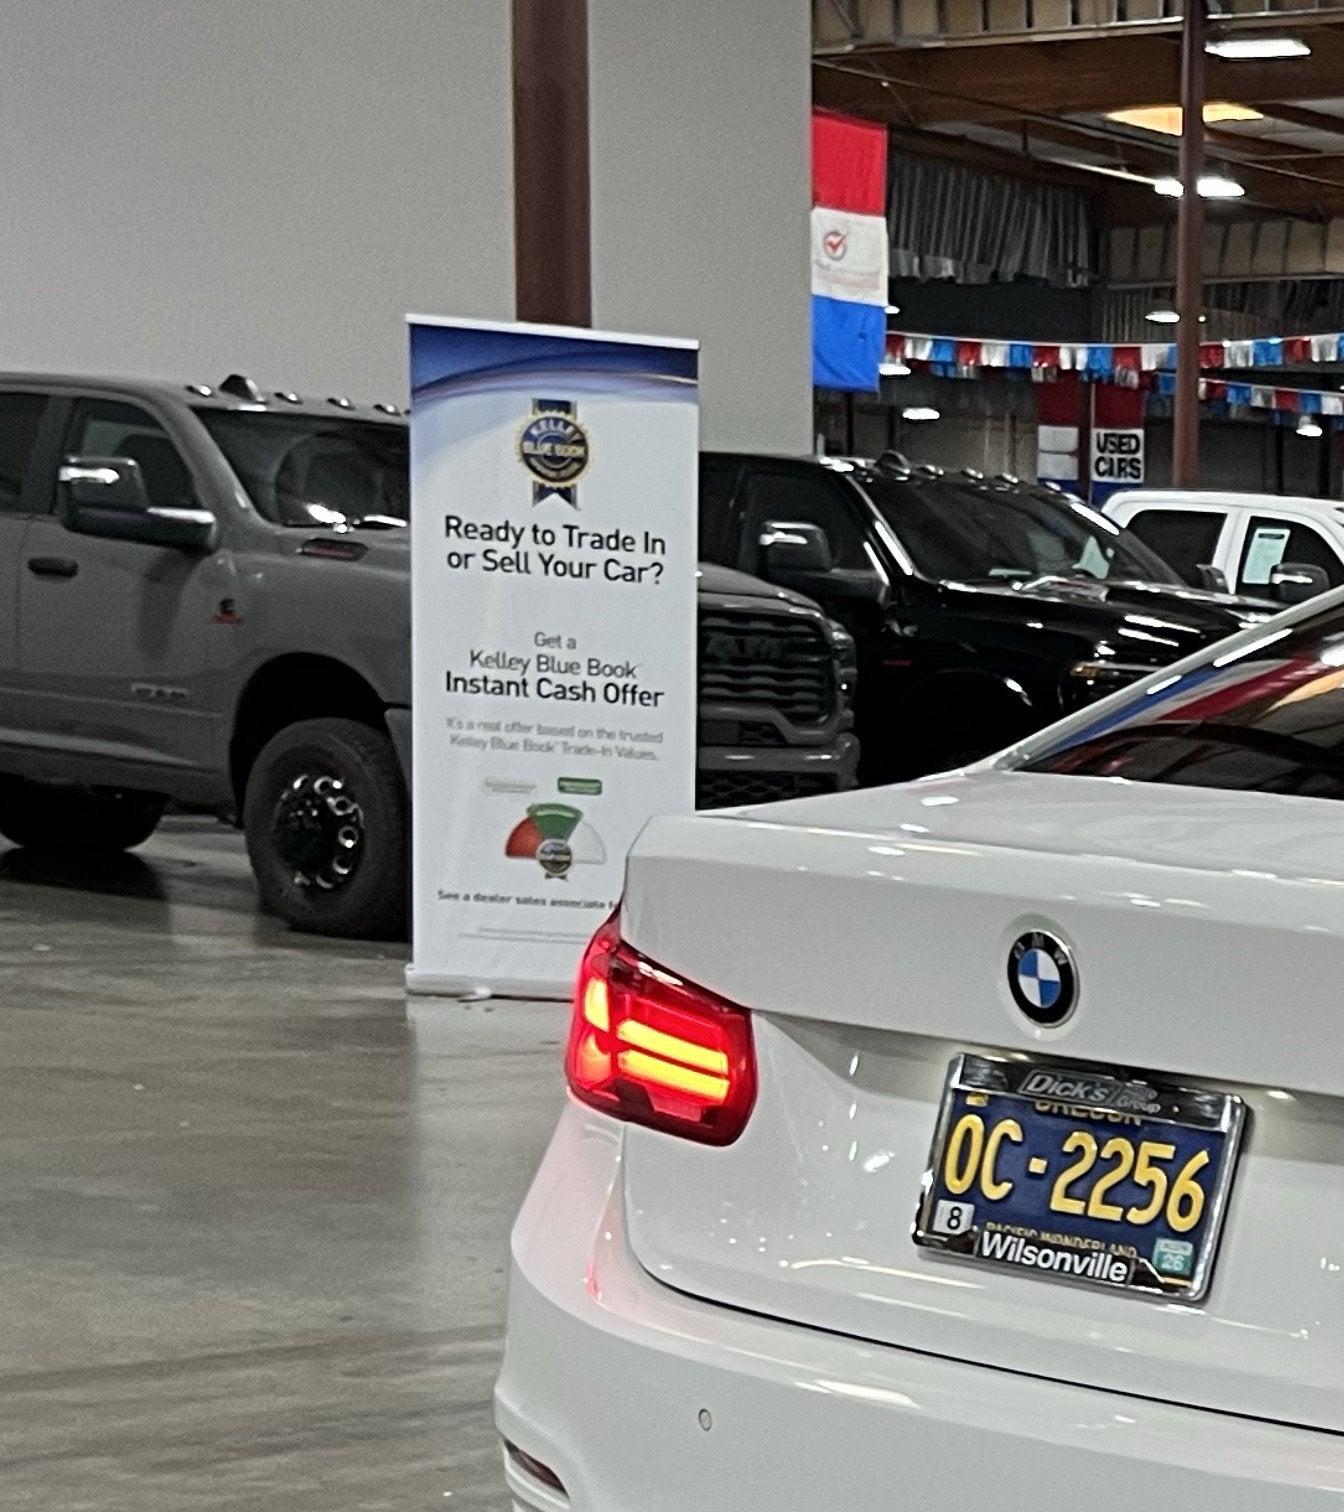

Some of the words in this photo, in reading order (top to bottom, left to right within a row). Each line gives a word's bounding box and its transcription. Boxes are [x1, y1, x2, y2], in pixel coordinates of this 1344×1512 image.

[1096, 433, 1140, 454] USED
[444, 515, 525, 550] Ready
[532, 523, 556, 546] to
[563, 524, 636, 552] Trade
[644, 531, 666, 555] In
[447, 552, 476, 569] or
[482, 549, 531, 575] Sell
[538, 553, 597, 579] Your
[604, 558, 664, 585] Car?
[534, 631, 562, 649] Get
[566, 637, 577, 650] a
[470, 649, 531, 676] Kelley
[536, 654, 581, 675] Blue
[587, 658, 638, 679] Book
[446, 670, 530, 698] Instant
[536, 678, 597, 703] Cash
[603, 682, 665, 708] Offer
[491, 736, 520, 750] Blue
[505, 721, 533, 733] offer
[577, 729, 594, 739] on
[596, 728, 616, 740] the
[619, 730, 664, 744] trusted
[947, 1206, 962, 1231] 8
[980, 1231, 1128, 1283] Wilsonville
[1161, 1254, 1185, 1271] 26
